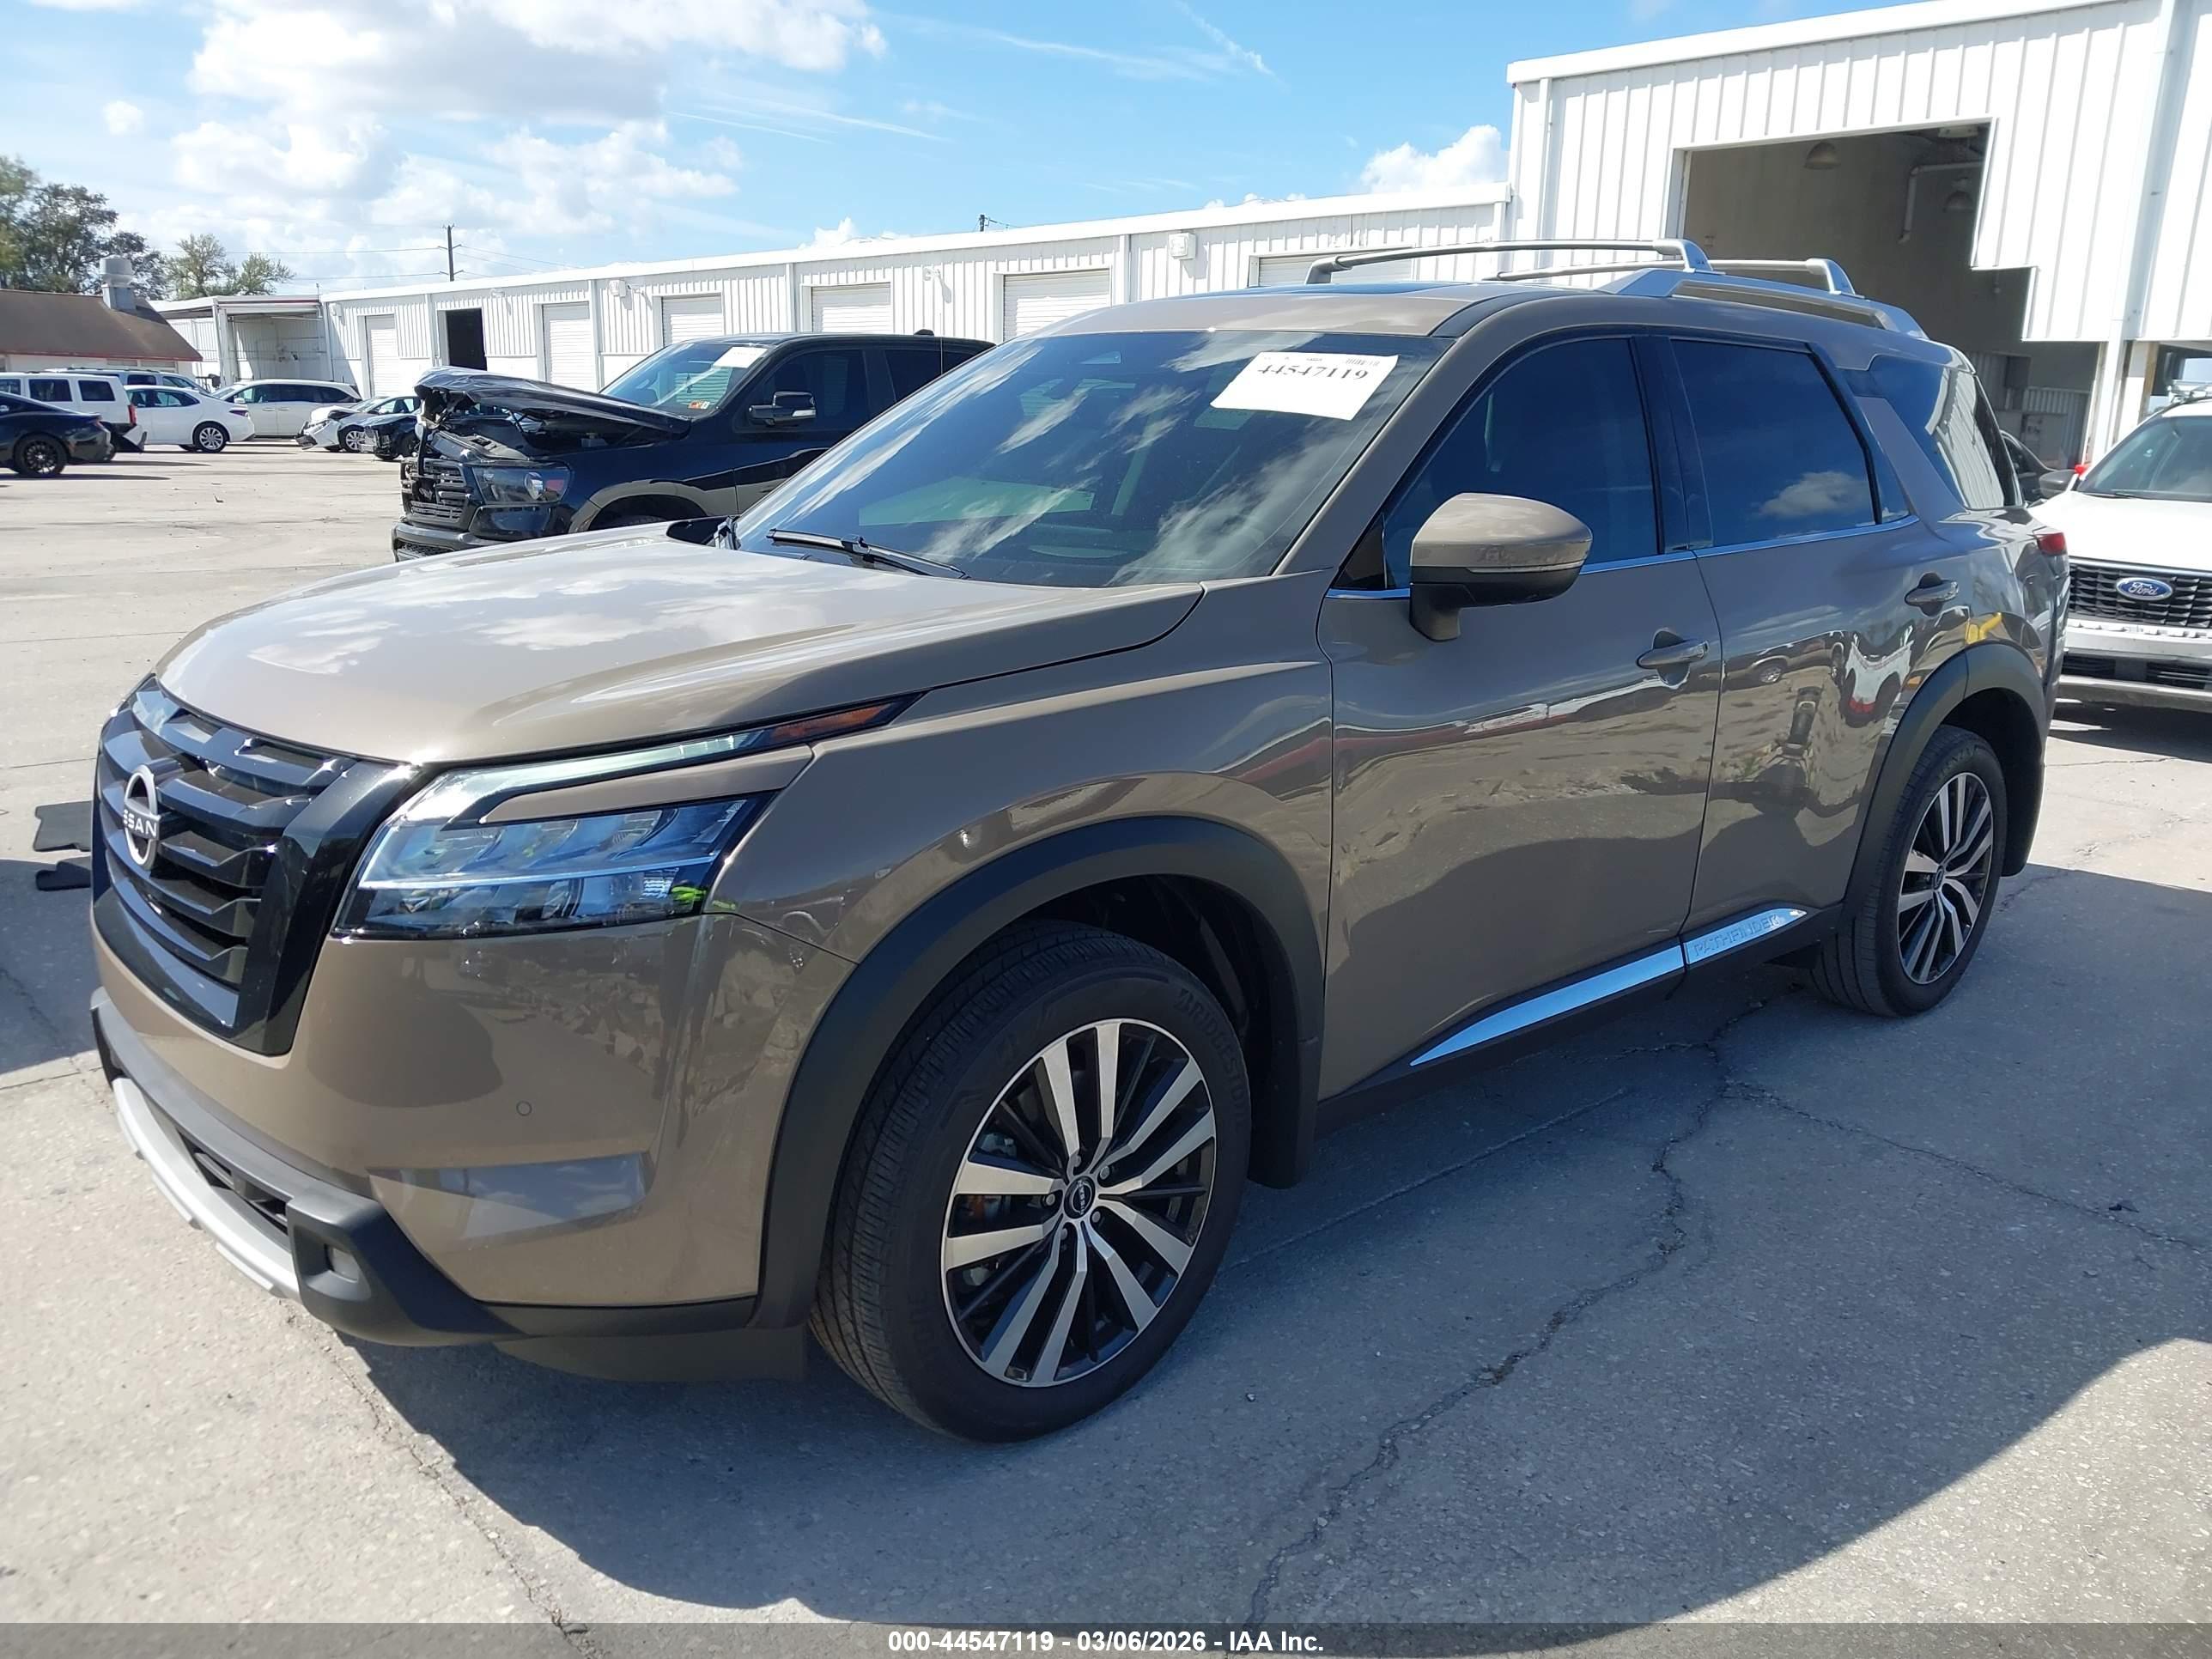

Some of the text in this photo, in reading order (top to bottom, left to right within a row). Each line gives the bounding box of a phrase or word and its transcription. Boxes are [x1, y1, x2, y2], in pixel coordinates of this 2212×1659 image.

[1257, 364, 1370, 380] 44547119
[2127, 581, 2159, 596] Ford
[1692, 914, 1782, 957] PATHFINDER
[1173, 988, 1247, 1132] BRIDGESTONE
